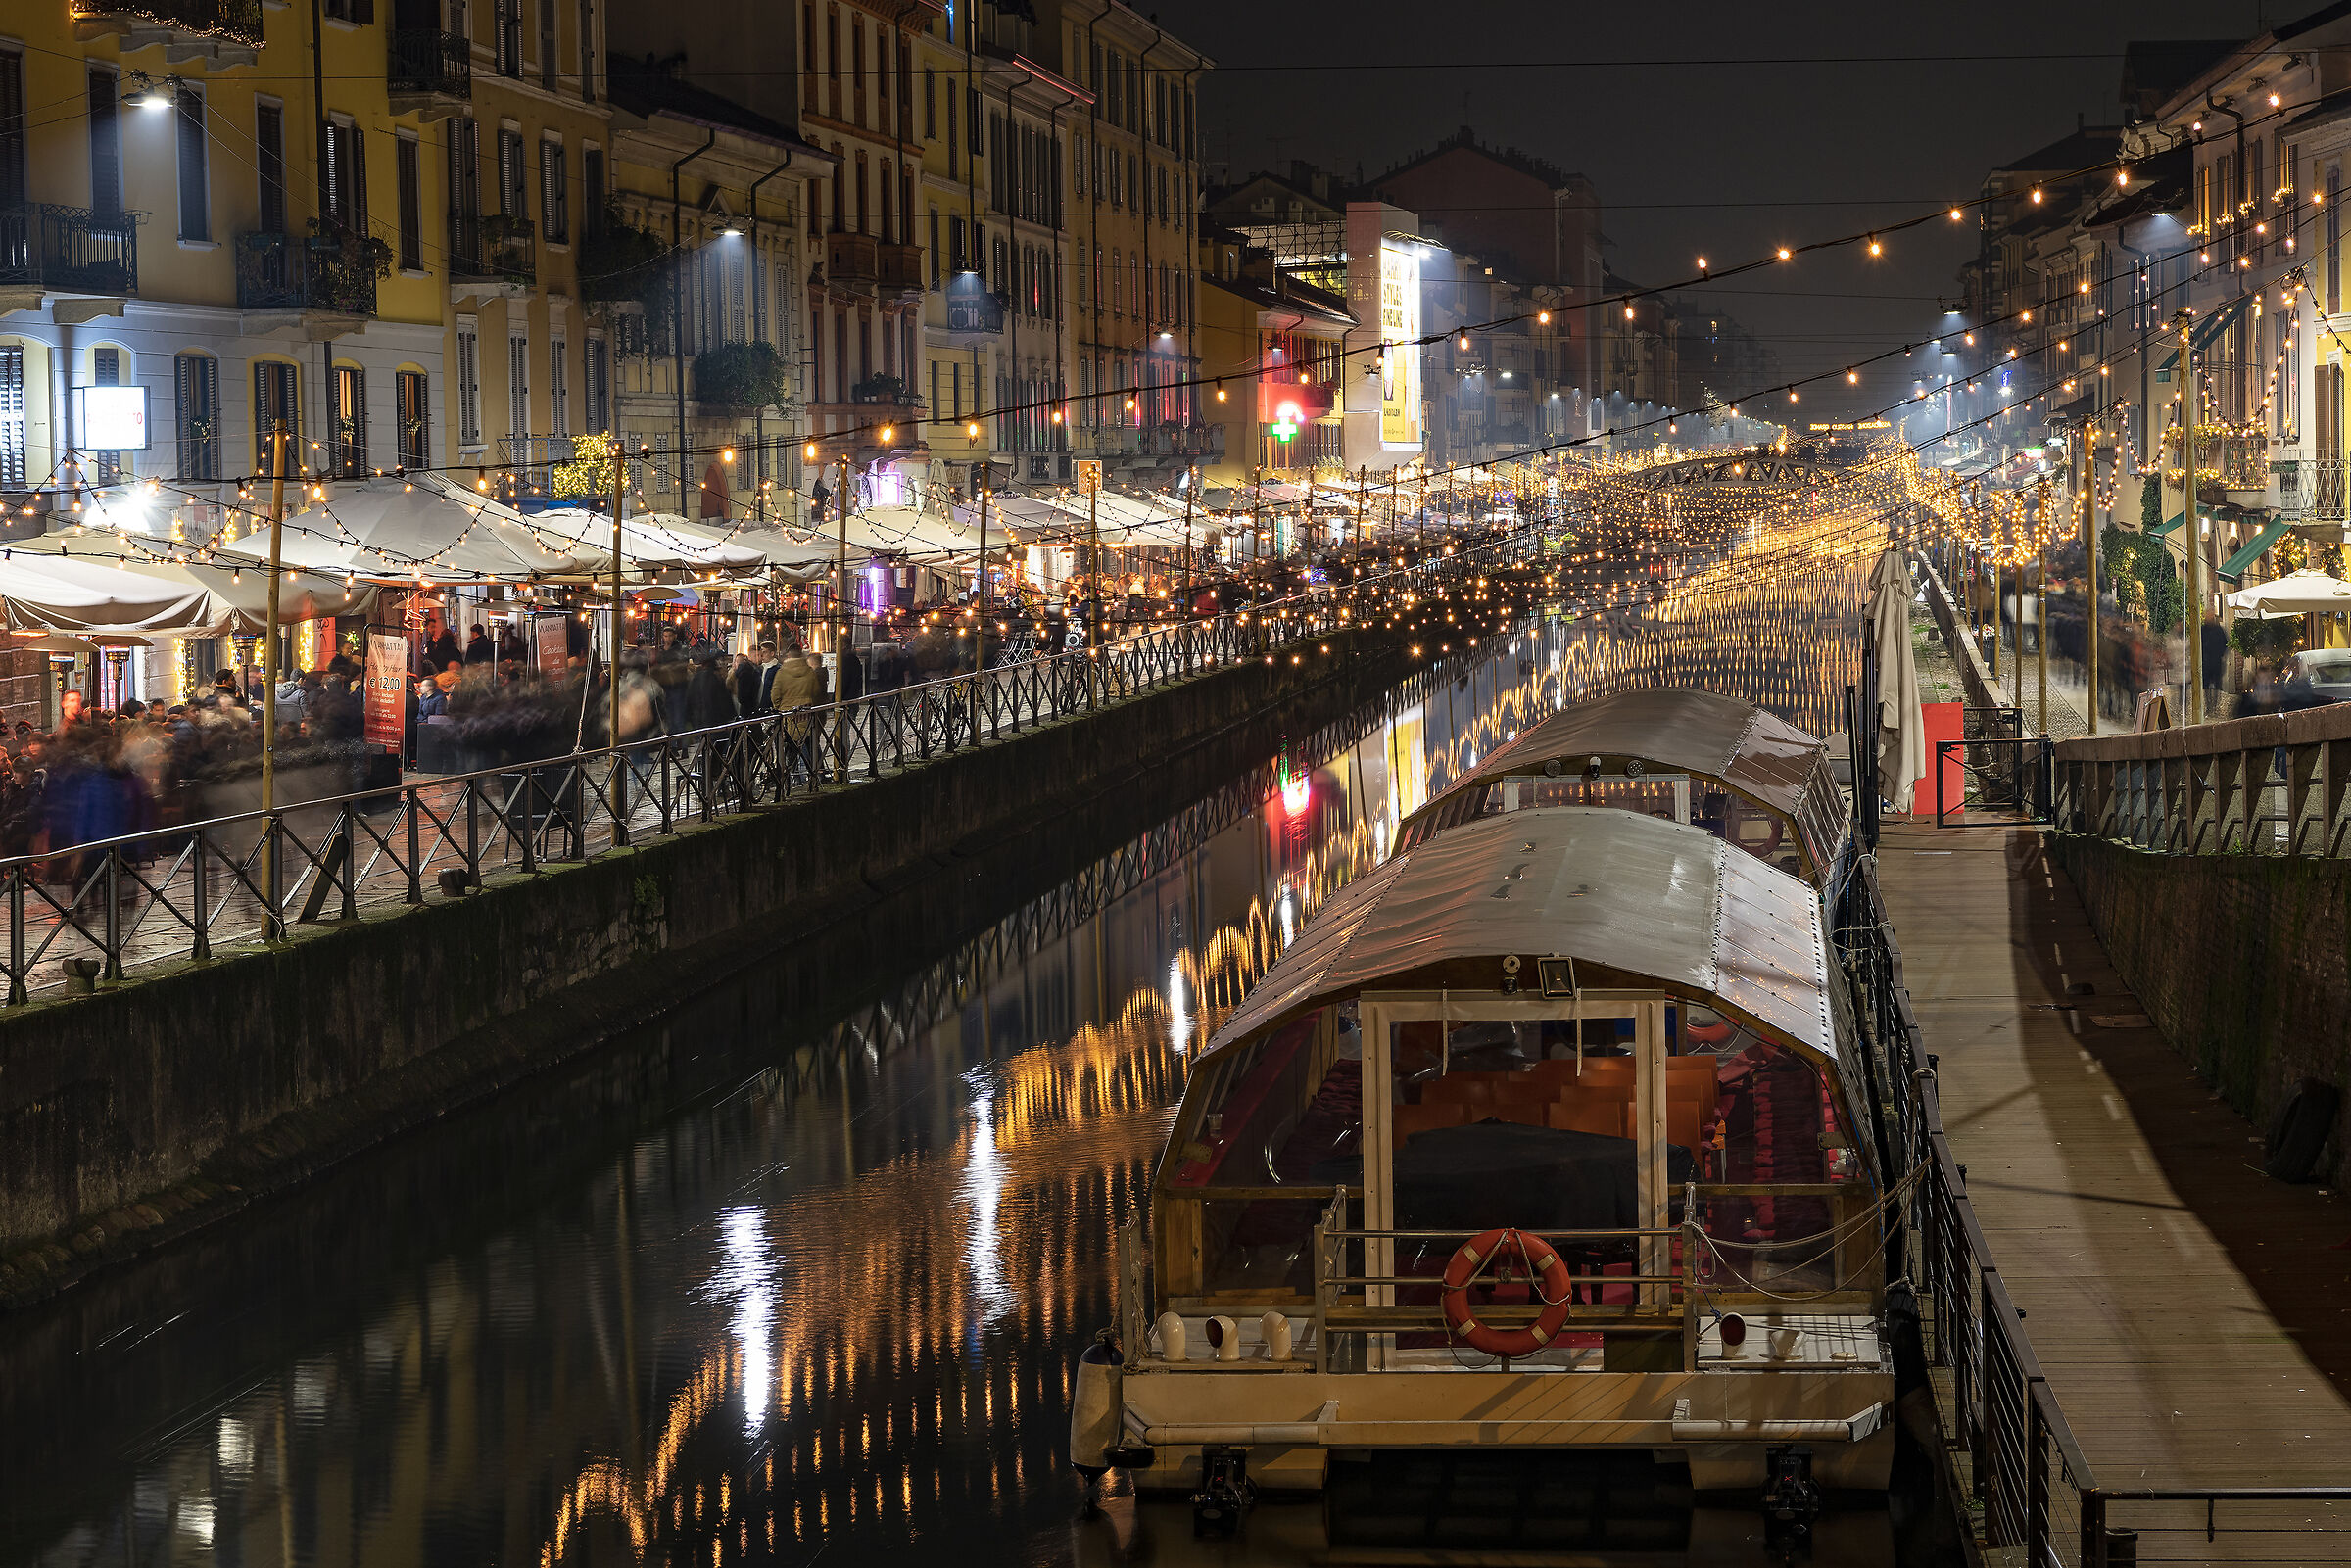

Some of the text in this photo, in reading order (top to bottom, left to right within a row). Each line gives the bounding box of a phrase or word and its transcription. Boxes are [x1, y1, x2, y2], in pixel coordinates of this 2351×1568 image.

[1383, 283, 1403, 306] STYLES
[1382, 308, 1403, 328] FINE LINE
[369, 676, 401, 691] € 12,00
